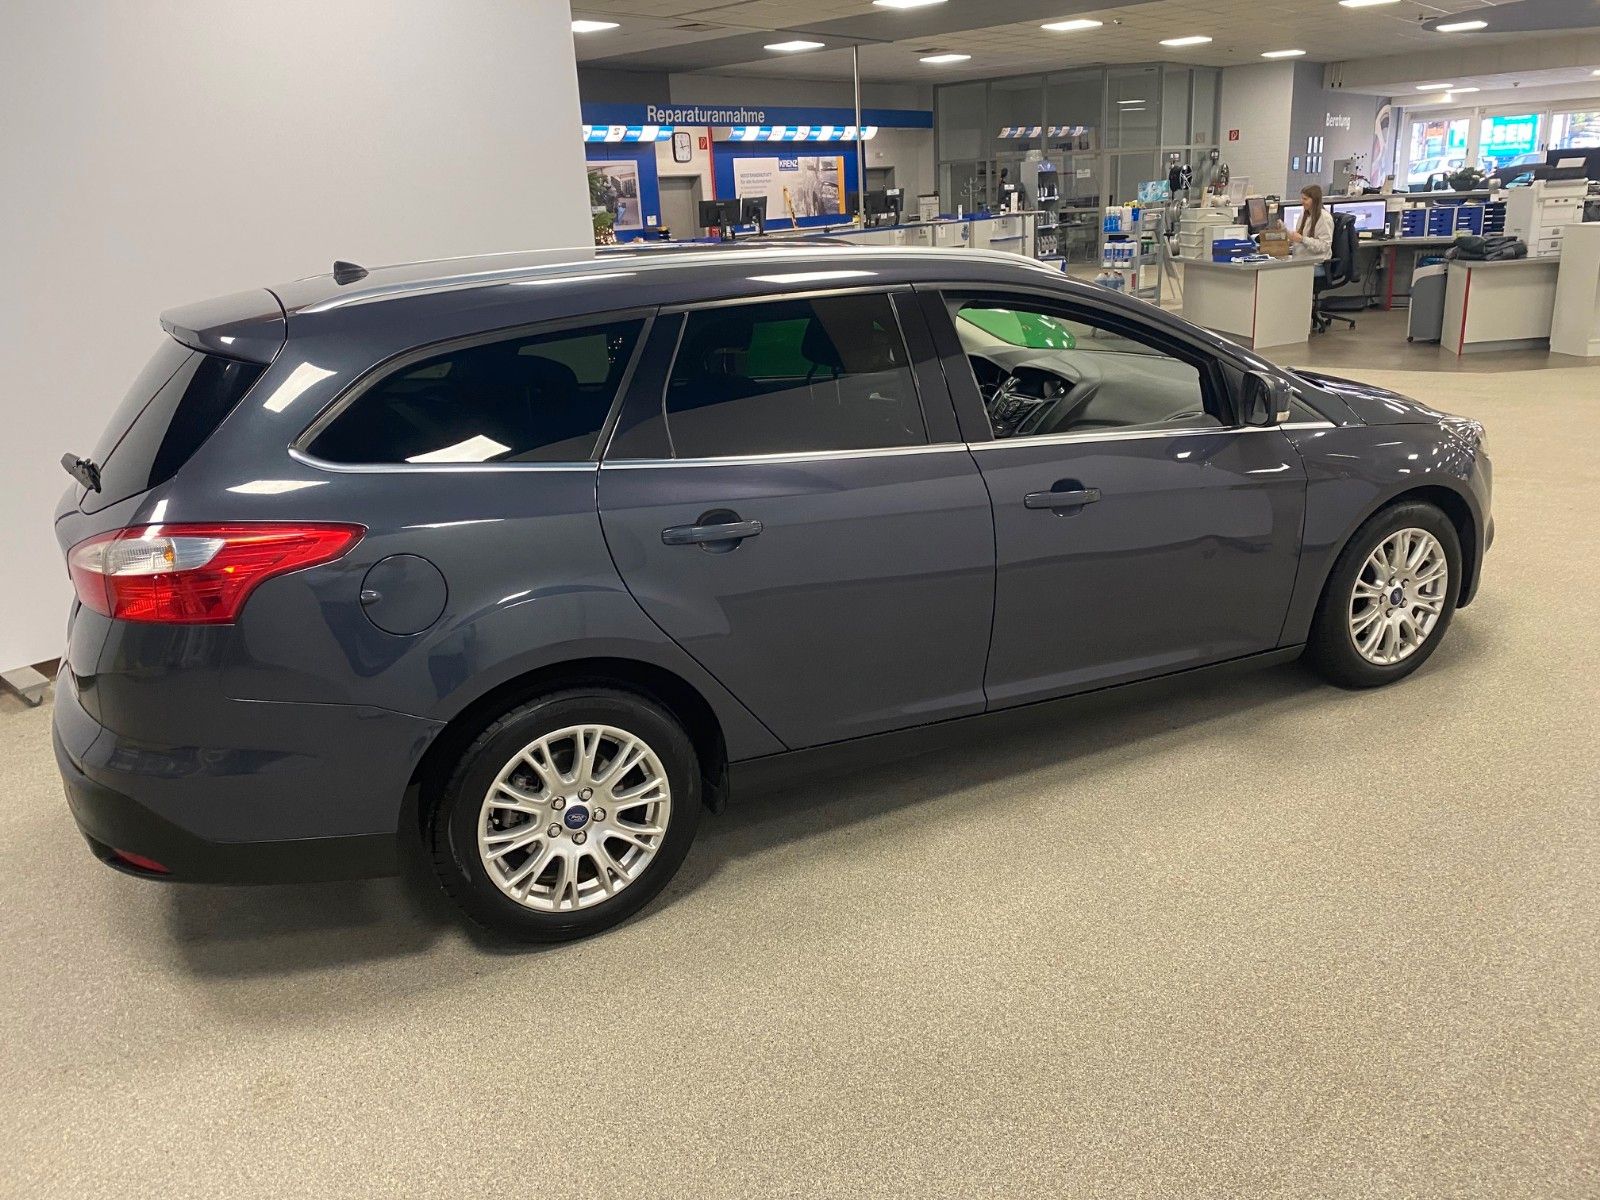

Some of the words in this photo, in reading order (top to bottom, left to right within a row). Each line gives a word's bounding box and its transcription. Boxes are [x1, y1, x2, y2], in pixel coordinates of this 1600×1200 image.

[647, 105, 765, 125] Reparaturannahme
[1326, 112, 1351, 131] Beratung
[779, 159, 798, 168] KRENZ
